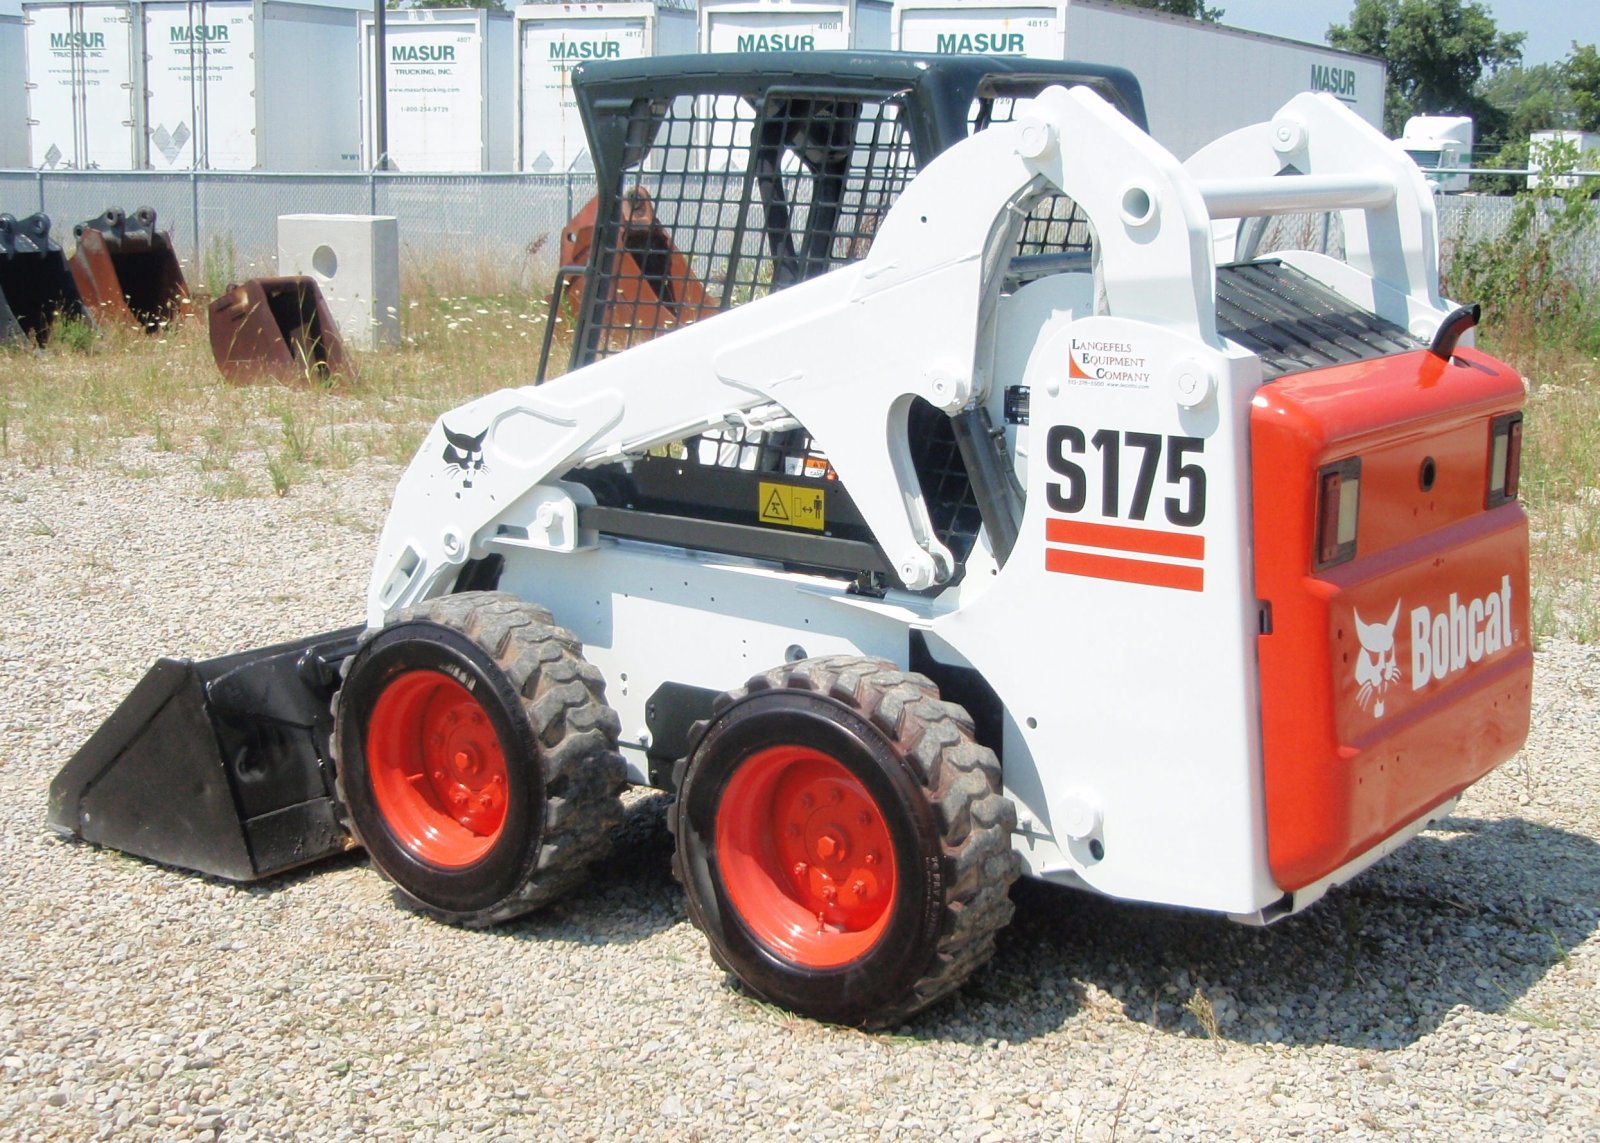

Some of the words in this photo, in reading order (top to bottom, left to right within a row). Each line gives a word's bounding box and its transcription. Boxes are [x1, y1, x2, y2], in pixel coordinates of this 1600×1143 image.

[1026, 20, 1049, 28] 4815
[50, 32, 105, 48] MASUR
[170, 25, 229, 41] MASUR
[550, 41, 620, 58] MASUR
[737, 33, 815, 52] MASUR
[937, 33, 1025, 54] MASUR
[392, 45, 455, 61] MASUR
[1311, 64, 1356, 96] MASUR
[1072, 338, 1132, 353] LANGEFELS
[1082, 352, 1146, 368] EQUIPMENT
[1096, 367, 1151, 383] COMPANY
[1045, 424, 1208, 528] S175
[1410, 574, 1513, 692] Bobcat
